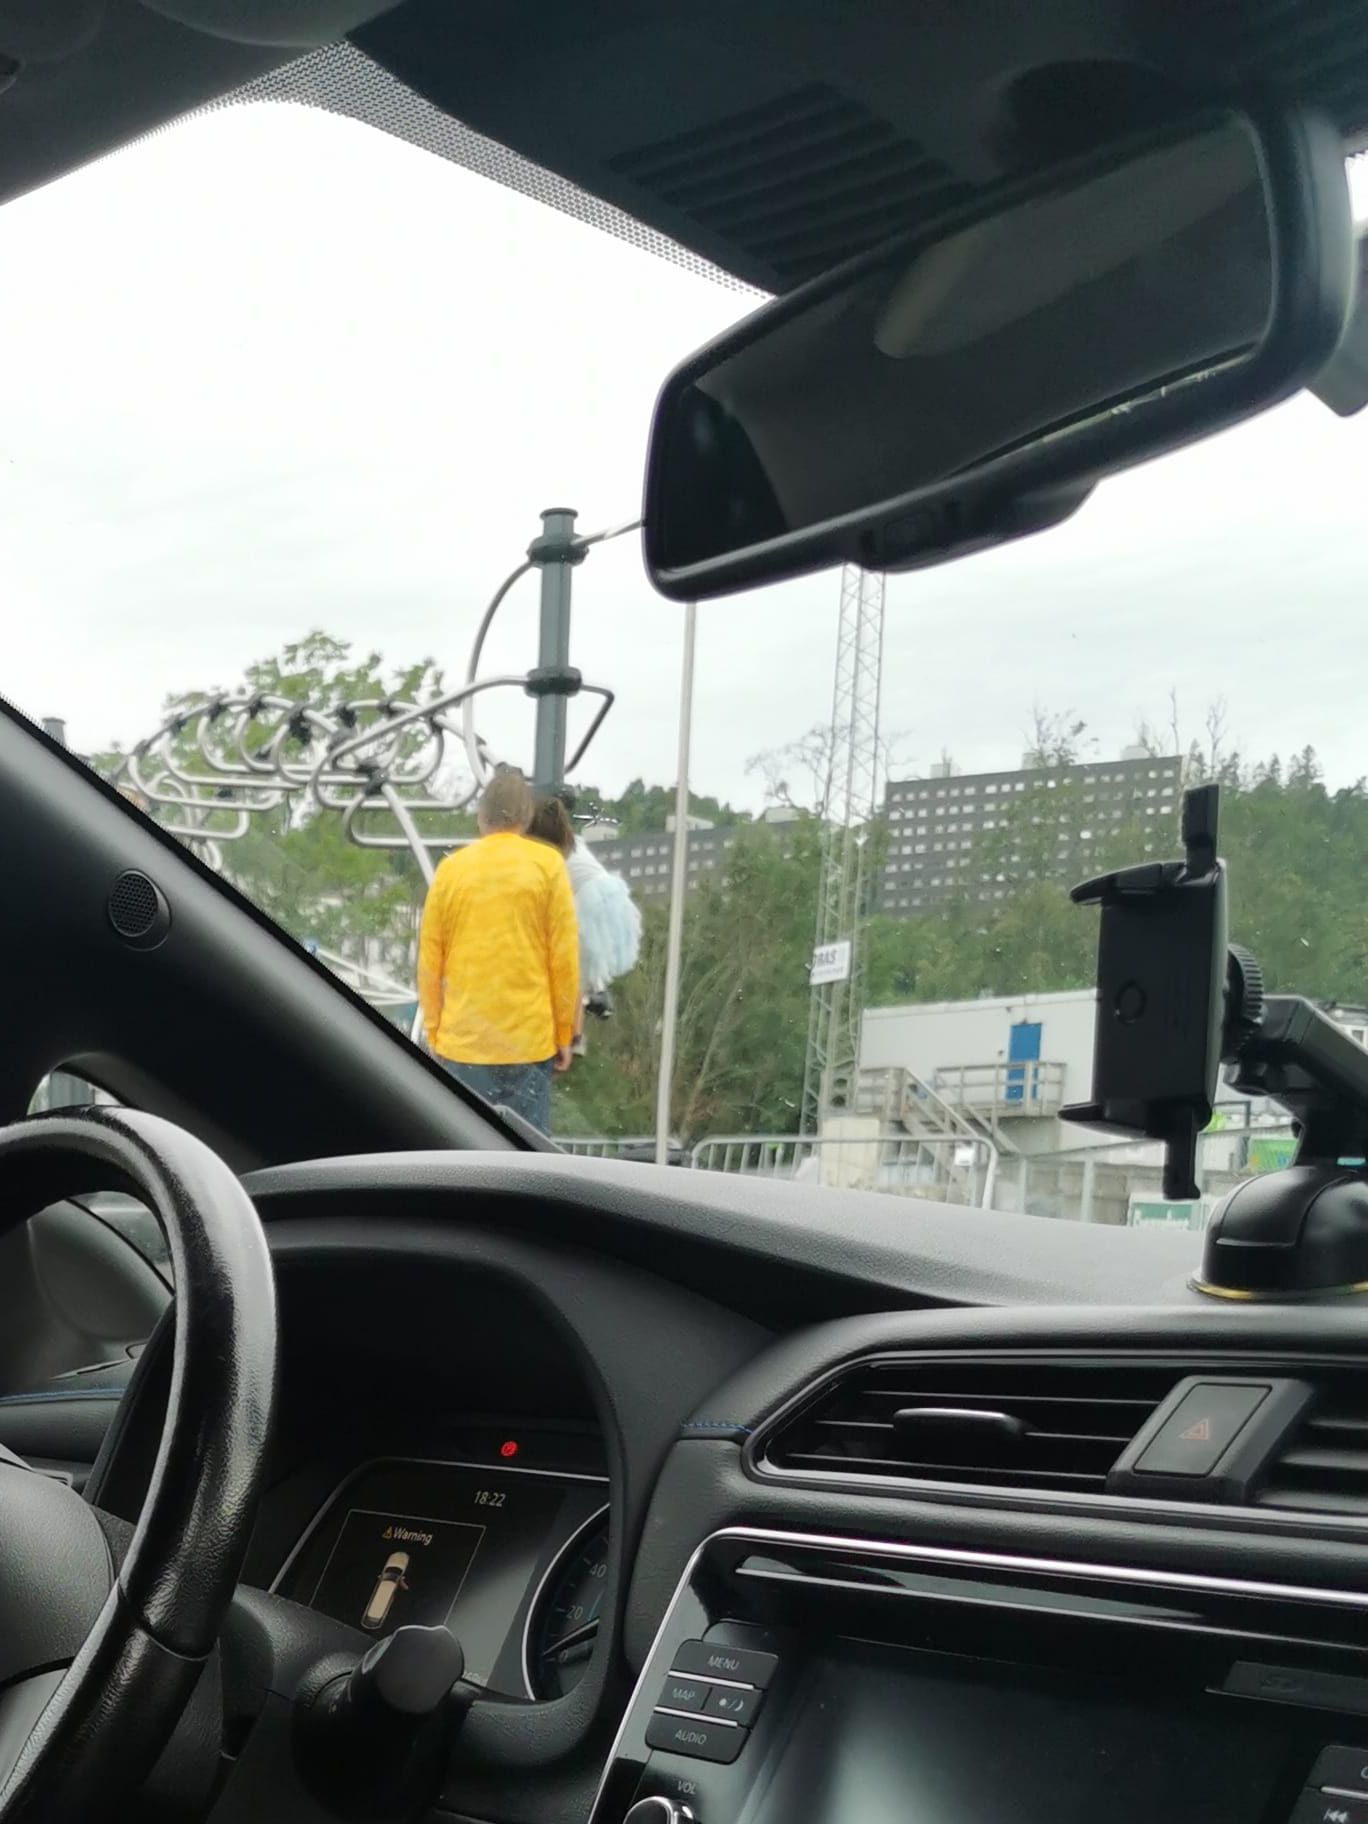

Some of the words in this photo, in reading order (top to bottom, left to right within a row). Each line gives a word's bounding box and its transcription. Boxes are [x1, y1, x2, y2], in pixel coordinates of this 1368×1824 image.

[473, 1490, 507, 1508] 18:22
[393, 1526, 433, 1546] Warning
[588, 1563, 607, 1579] 40
[565, 1605, 584, 1620] 20
[707, 1655, 740, 1671] MENU
[672, 1687, 695, 1701] MAP
[674, 1729, 707, 1745] AUDIO
[677, 1780, 697, 1795] VOL
